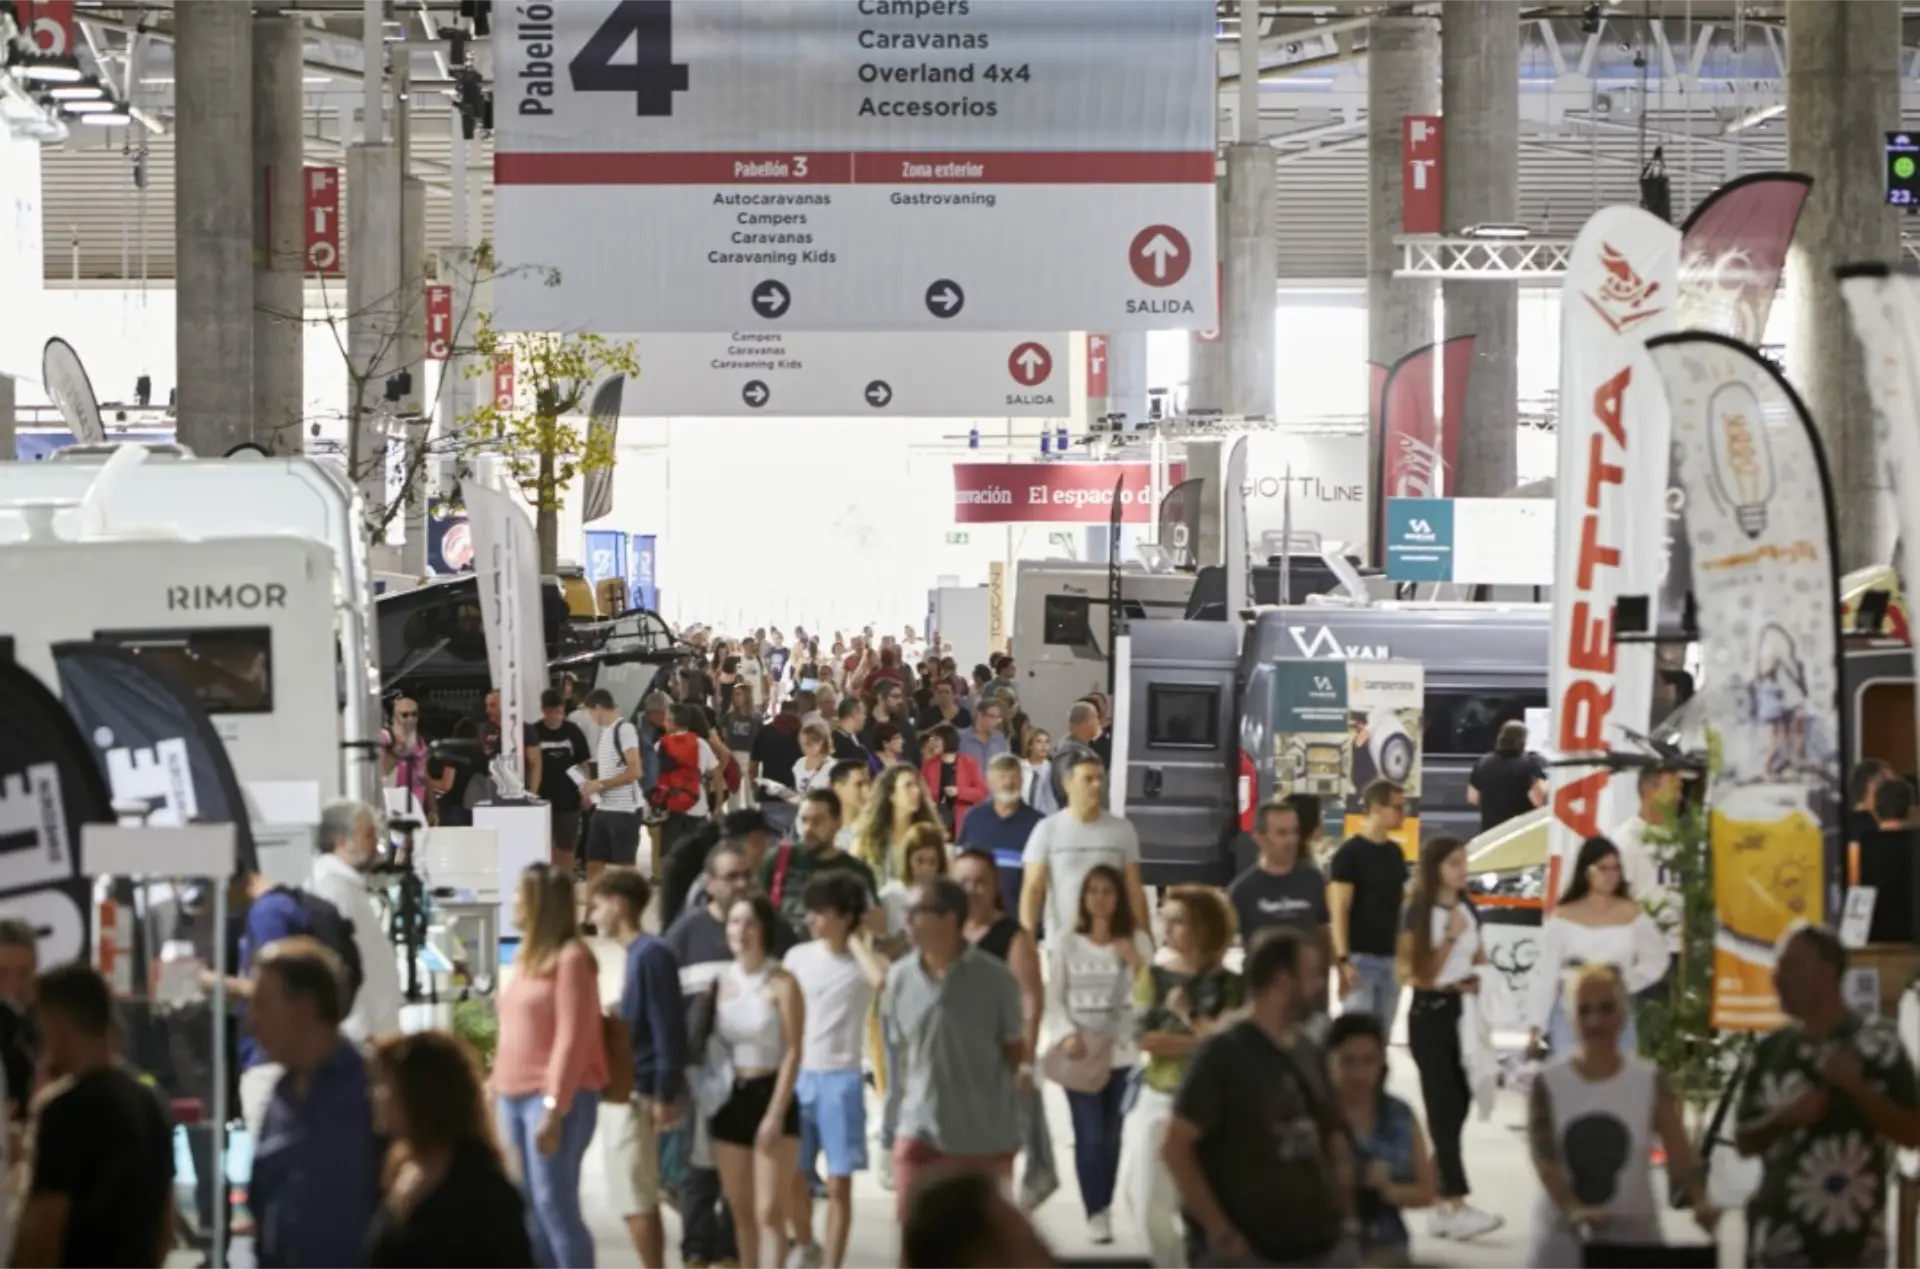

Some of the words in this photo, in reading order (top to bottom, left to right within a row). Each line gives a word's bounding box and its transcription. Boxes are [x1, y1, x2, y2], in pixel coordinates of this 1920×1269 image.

[858, 0, 970, 19] Campers
[858, 29, 989, 50] Caravanas
[516, 0, 554, 116] Pabelló
[569, 0, 690, 117] 4
[858, 62, 975, 84] Overland
[982, 63, 1031, 84] 4x4
[858, 96, 998, 118] Accesorios
[734, 160, 789, 178] Pabellón
[792, 156, 808, 178] 3
[902, 162, 933, 178] Zona
[935, 162, 985, 178] exterior
[712, 192, 831, 207] Autocaravanas
[890, 191, 996, 208] Gastrovaning
[737, 211, 807, 226] Campers
[730, 231, 813, 245] Caravanas
[708, 250, 798, 266] Caravaning
[802, 250, 837, 264] Kids
[1125, 299, 1195, 314] SALIDA
[731, 331, 782, 343] Campers
[727, 345, 786, 356] Caravanas
[710, 358, 775, 371] Caravaning
[777, 358, 803, 370] Kids
[1005, 394, 1055, 405] SALIDA
[1029, 485, 1048, 504] El
[1053, 486, 1134, 509] espaco
[167, 583, 287, 611] RIMOR
